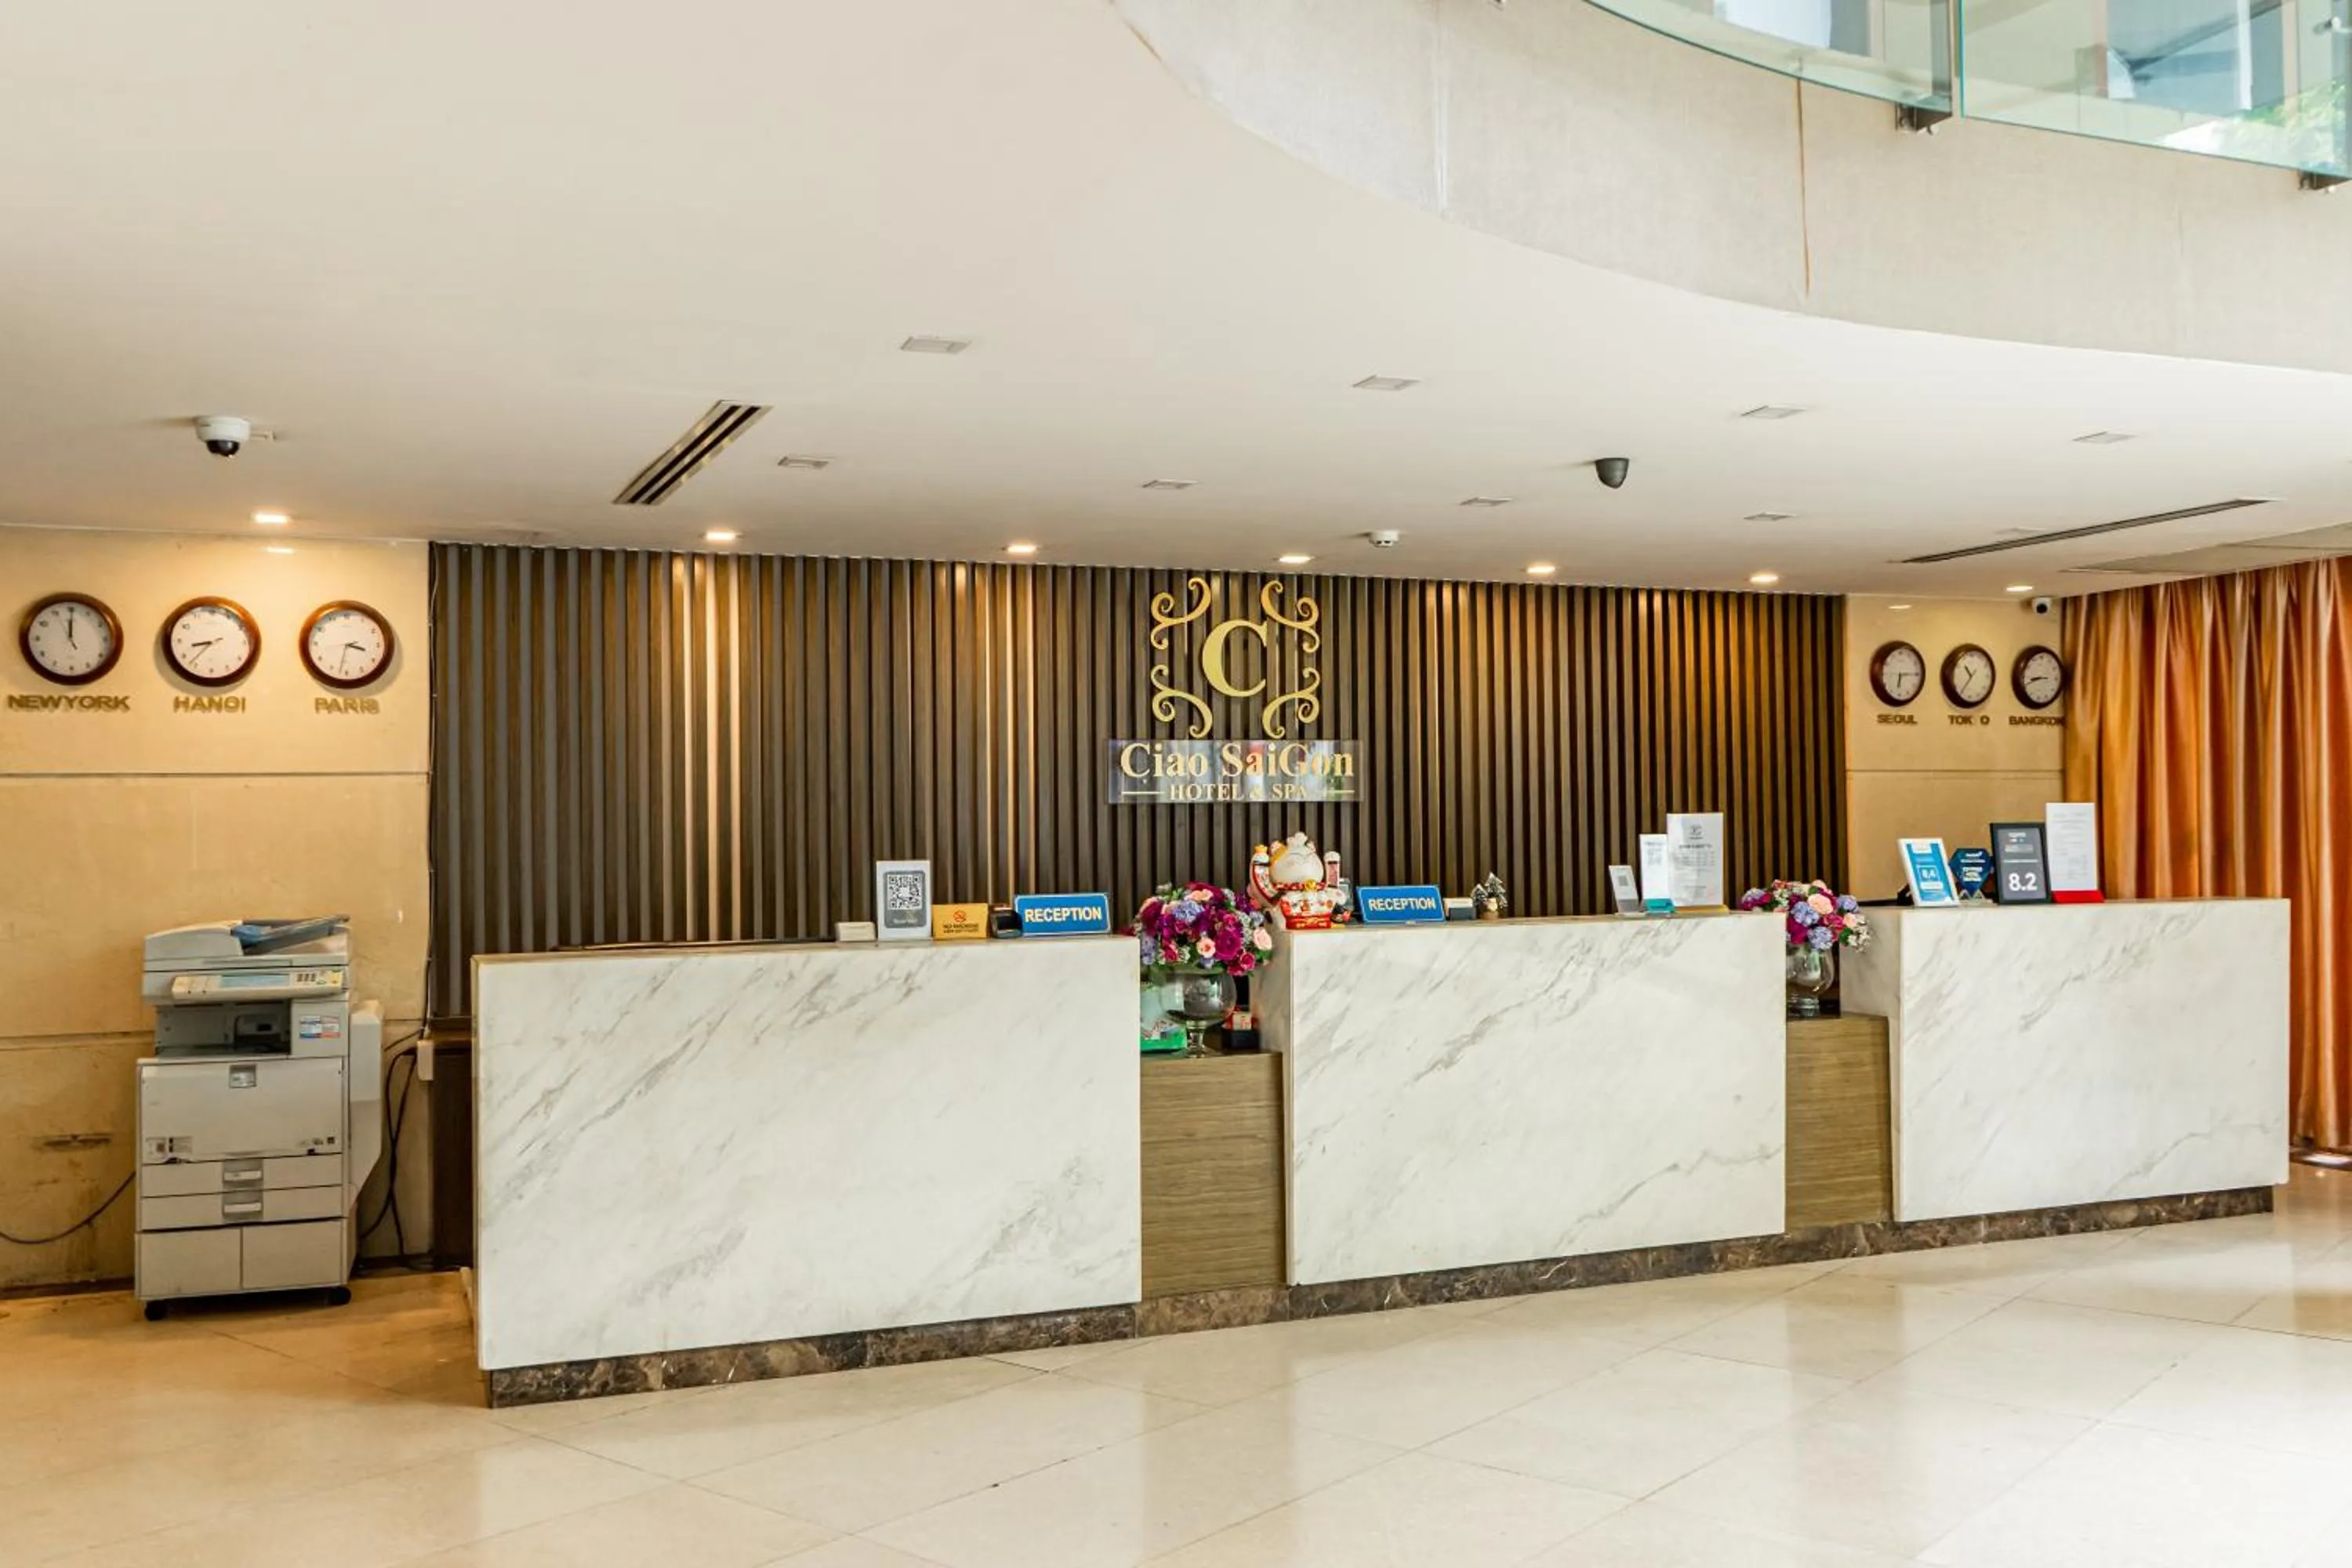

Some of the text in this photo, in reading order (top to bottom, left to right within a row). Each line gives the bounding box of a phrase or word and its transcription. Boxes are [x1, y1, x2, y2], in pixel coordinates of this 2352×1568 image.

[1202, 619, 1268, 697] C
[7, 695, 131, 711] NEWYORK
[173, 696, 246, 713] HANOI
[314, 697, 380, 714] PARIS
[1877, 713, 1918, 724] SEOUL
[1120, 742, 1354, 778] Ciao SaiGon
[1169, 784, 1308, 800] HOTEL & SPA
[2009, 872, 2038, 891] 8.2
[1368, 897, 1437, 911] RECEPTION
[1025, 906, 1102, 923] RECEPTION
